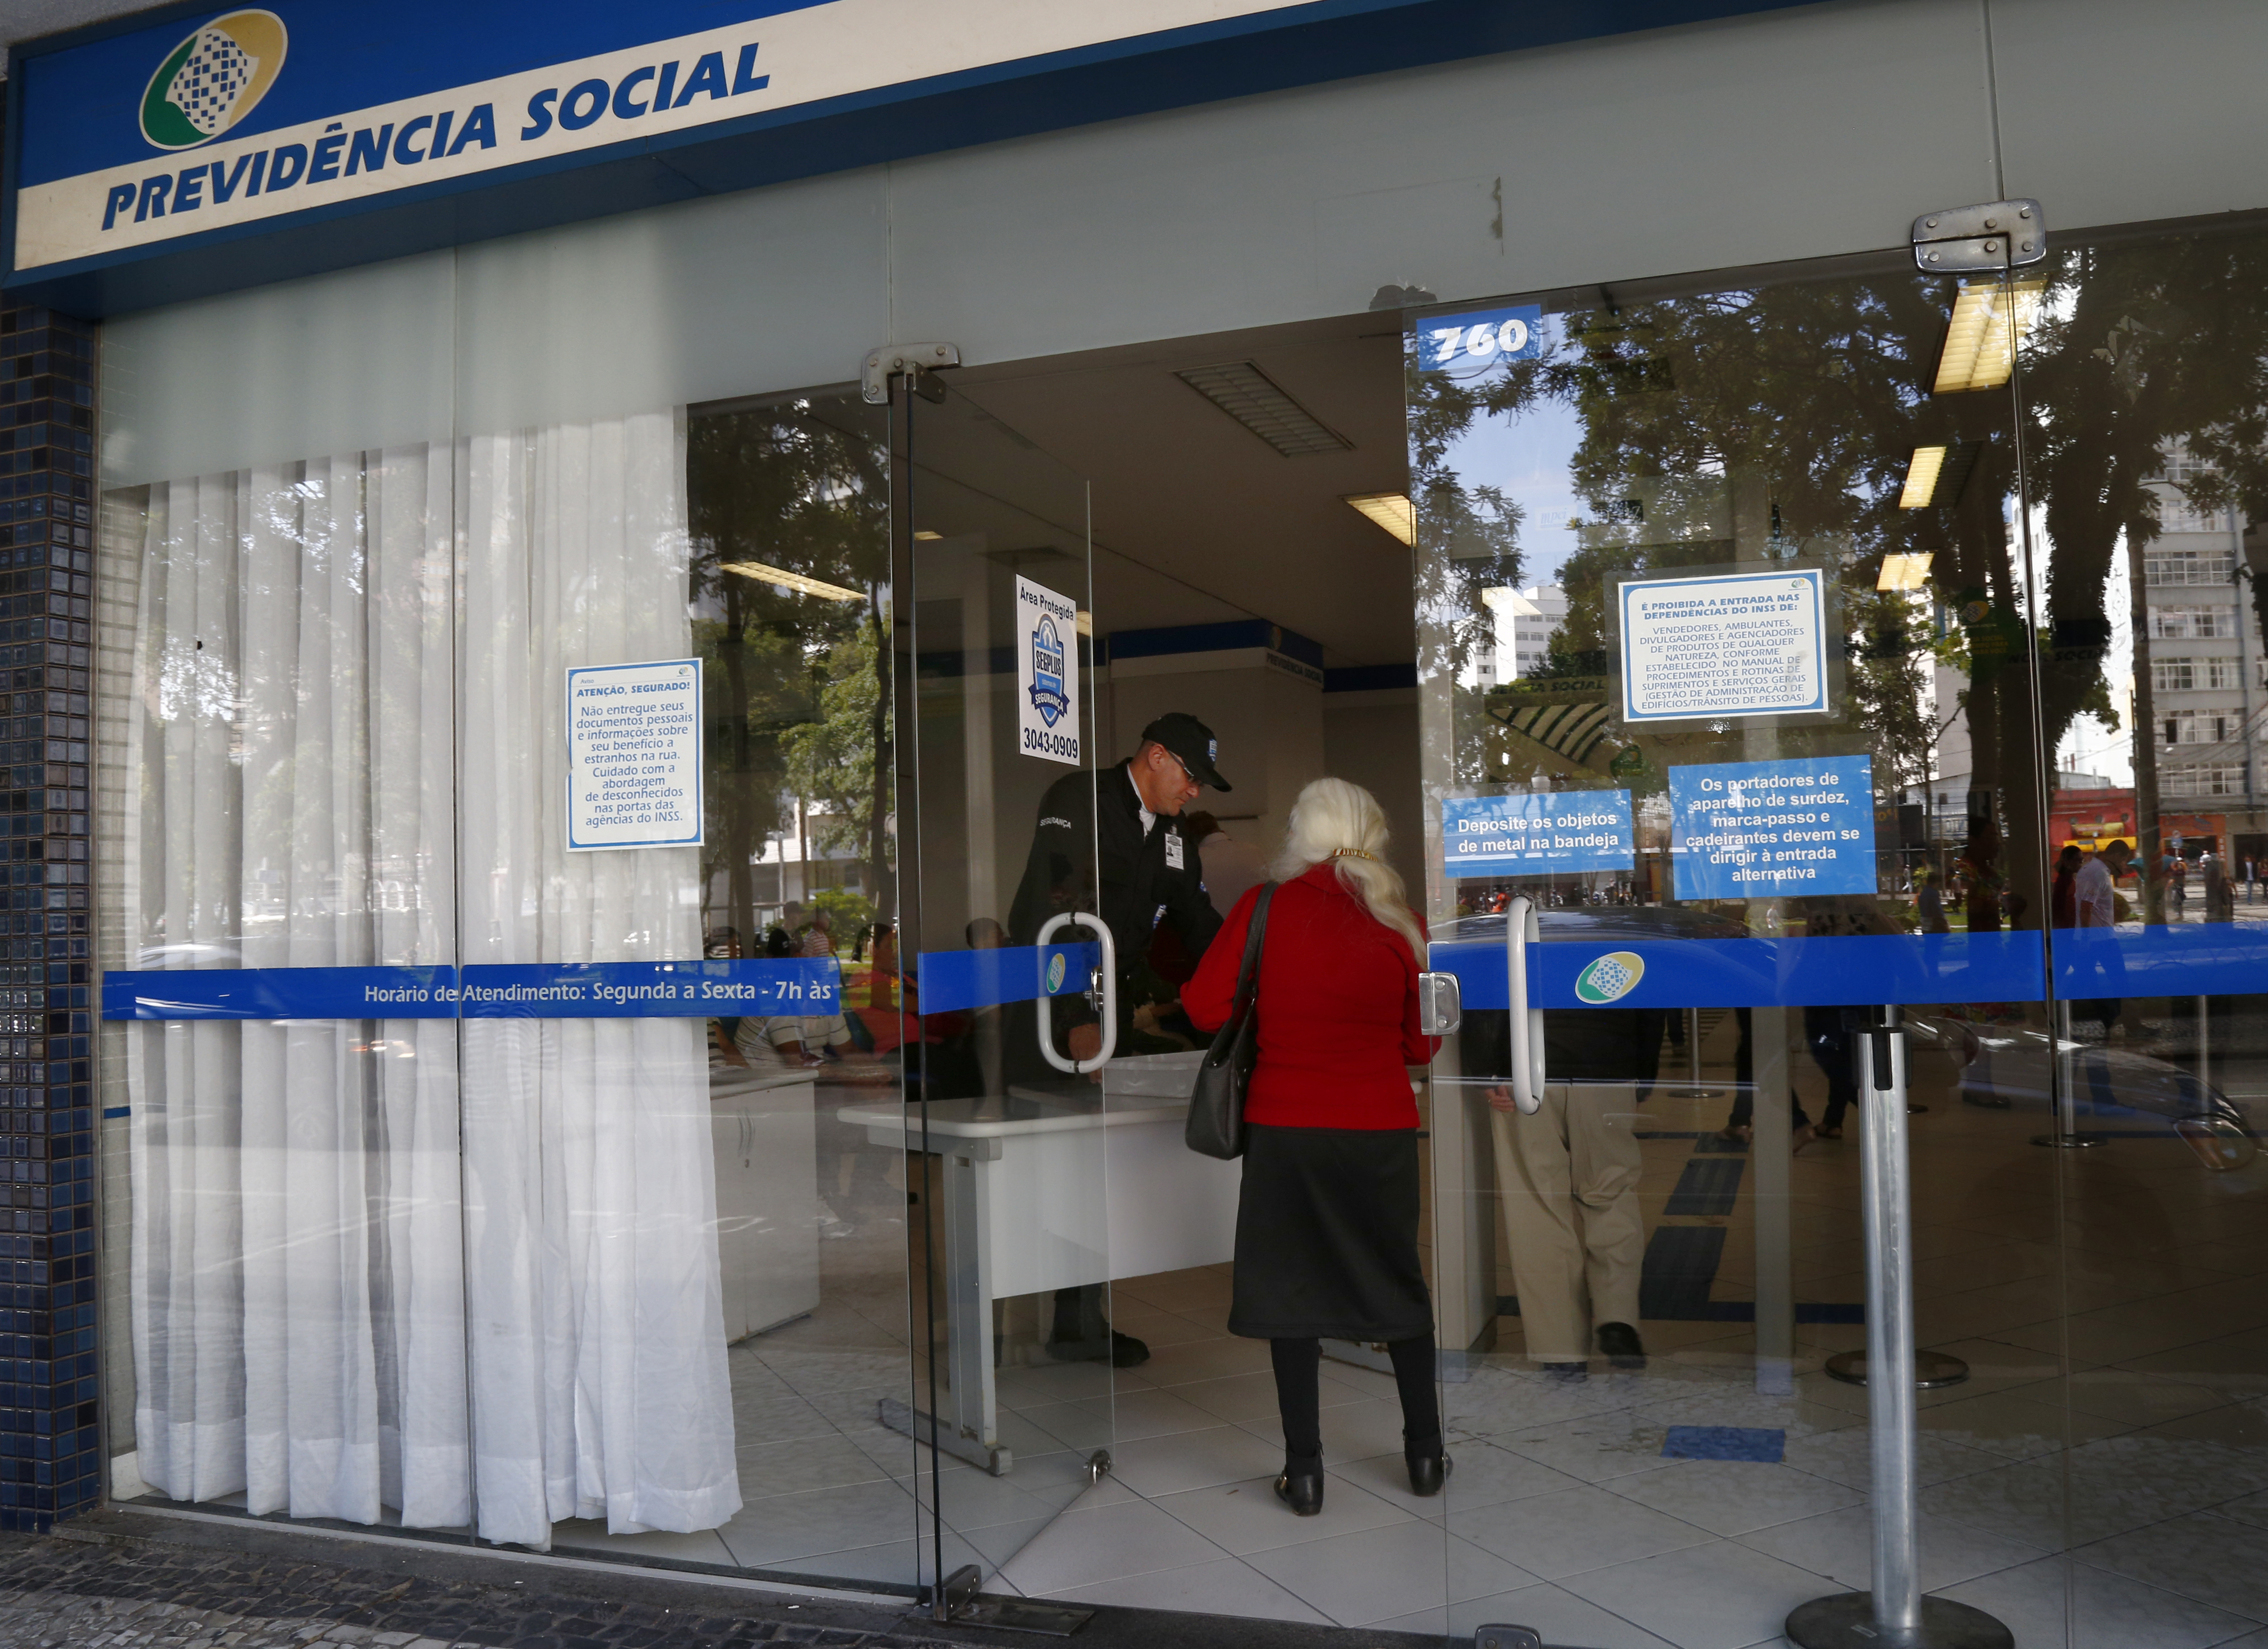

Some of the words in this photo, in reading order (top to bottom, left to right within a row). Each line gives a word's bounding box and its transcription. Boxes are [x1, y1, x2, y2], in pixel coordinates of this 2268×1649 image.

[101, 103, 498, 231] PREVIDÊNCIA
[522, 43, 770, 141] SOCIAL
[1435, 319, 1528, 360] 760
[1021, 583, 1038, 606] Área
[1040, 594, 1074, 621] Protegida
[1642, 602, 1648, 611] É
[1652, 600, 1705, 610] PROIBIDA
[1720, 596, 1774, 605] ENTRADA
[1777, 593, 1800, 602] NAS
[1644, 607, 1727, 620] DEPENDÊNCIAS
[1752, 605, 1775, 613] INSS
[1653, 624, 1721, 634] VENDEDORES,
[1725, 619, 1793, 630] AMBULANTES,
[1640, 634, 1715, 644] DIVULGADORES
[1727, 628, 1804, 639] AGENCIADORES
[1667, 642, 1719, 652] PRODUTOS
[1739, 638, 1794, 648] QUALQUER
[1666, 652, 1719, 661] NATUREZA,
[1723, 648, 1779, 658] CONFORME
[1036, 650, 1061, 676] SEGPLUS
[1646, 661, 1716, 672] ESTABELECIDO
[1742, 657, 1784, 666] MANUAL
[1647, 670, 1729, 681] PROCEDIMENTOS
[1742, 667, 1784, 675] ROTINAS
[577, 685, 627, 697] ATENÇÃO,
[631, 682, 690, 693] SEGURADO!
[1551, 680, 1604, 692] SOCIAL
[1642, 680, 1709, 691] SUPRIMENTOS
[1722, 677, 1768, 686] SERVIÇOS
[1772, 675, 1806, 685] GERAIS
[1646, 690, 1686, 701] (GESTÃO
[1706, 684, 1787, 697] ADMINISTRAÇÃO
[581, 706, 603, 716] Não
[607, 704, 656, 716] entregue
[660, 703, 684, 711] seus
[1035, 692, 1064, 712] SEGURANÇA
[1642, 697, 1739, 709] EDIFÍCIOS/TRÂNSITO
[1760, 694, 1807, 703] PESSOAS).
[577, 717, 643, 729] documentos
[647, 712, 692, 727] pessoais
[588, 727, 653, 741] informações
[658, 725, 688, 735] sobre
[613, 738, 663, 750] benefício
[1024, 727, 1078, 759] 3043-0909
[585, 753, 637, 764] estranhos
[593, 766, 638, 777] Cuidado
[642, 766, 664, 774] com
[603, 778, 665, 791] abordagem
[1701, 779, 1722, 791] Os
[1728, 775, 1814, 792] portadores
[1820, 772, 1838, 785] de
[585, 792, 598, 802] de
[603, 787, 683, 801] desconhecidos
[1693, 796, 1762, 812] aparelho
[1767, 794, 1785, 806] de
[1791, 791, 1849, 805] surdez,
[617, 802, 651, 815] portas
[655, 800, 673, 809] das
[586, 815, 633, 828] agências
[637, 813, 651, 823] do
[655, 811, 682, 822] INSS.
[1040, 817, 1071, 829] SEGURANÇA
[1459, 817, 1528, 834] Deposite
[1533, 818, 1552, 828] os
[1557, 813, 1616, 829] objetos
[1713, 813, 1815, 828] marca-passo
[1821, 813, 1830, 822] e
[1459, 840, 1477, 852] de
[1483, 837, 1525, 851] metal
[1531, 839, 1549, 849] na
[1555, 833, 1618, 849] bandeja
[1687, 832, 1777, 847] cadeirantes
[1783, 830, 1835, 842] devem
[1842, 830, 1859, 839] se
[1711, 850, 1757, 865] dirigir
[1763, 849, 1770, 861] à
[1776, 846, 1836, 861] entrada
[1732, 866, 1816, 882] alternativa
[366, 986, 428, 1001] Horário
[434, 986, 458, 1001] de
[462, 984, 585, 1001] Atendimento:
[594, 982, 676, 1004] Segunda
[684, 986, 694, 998] a
[702, 982, 754, 999] Sexta
[776, 982, 801, 999] 7h
[810, 981, 830, 999] às
